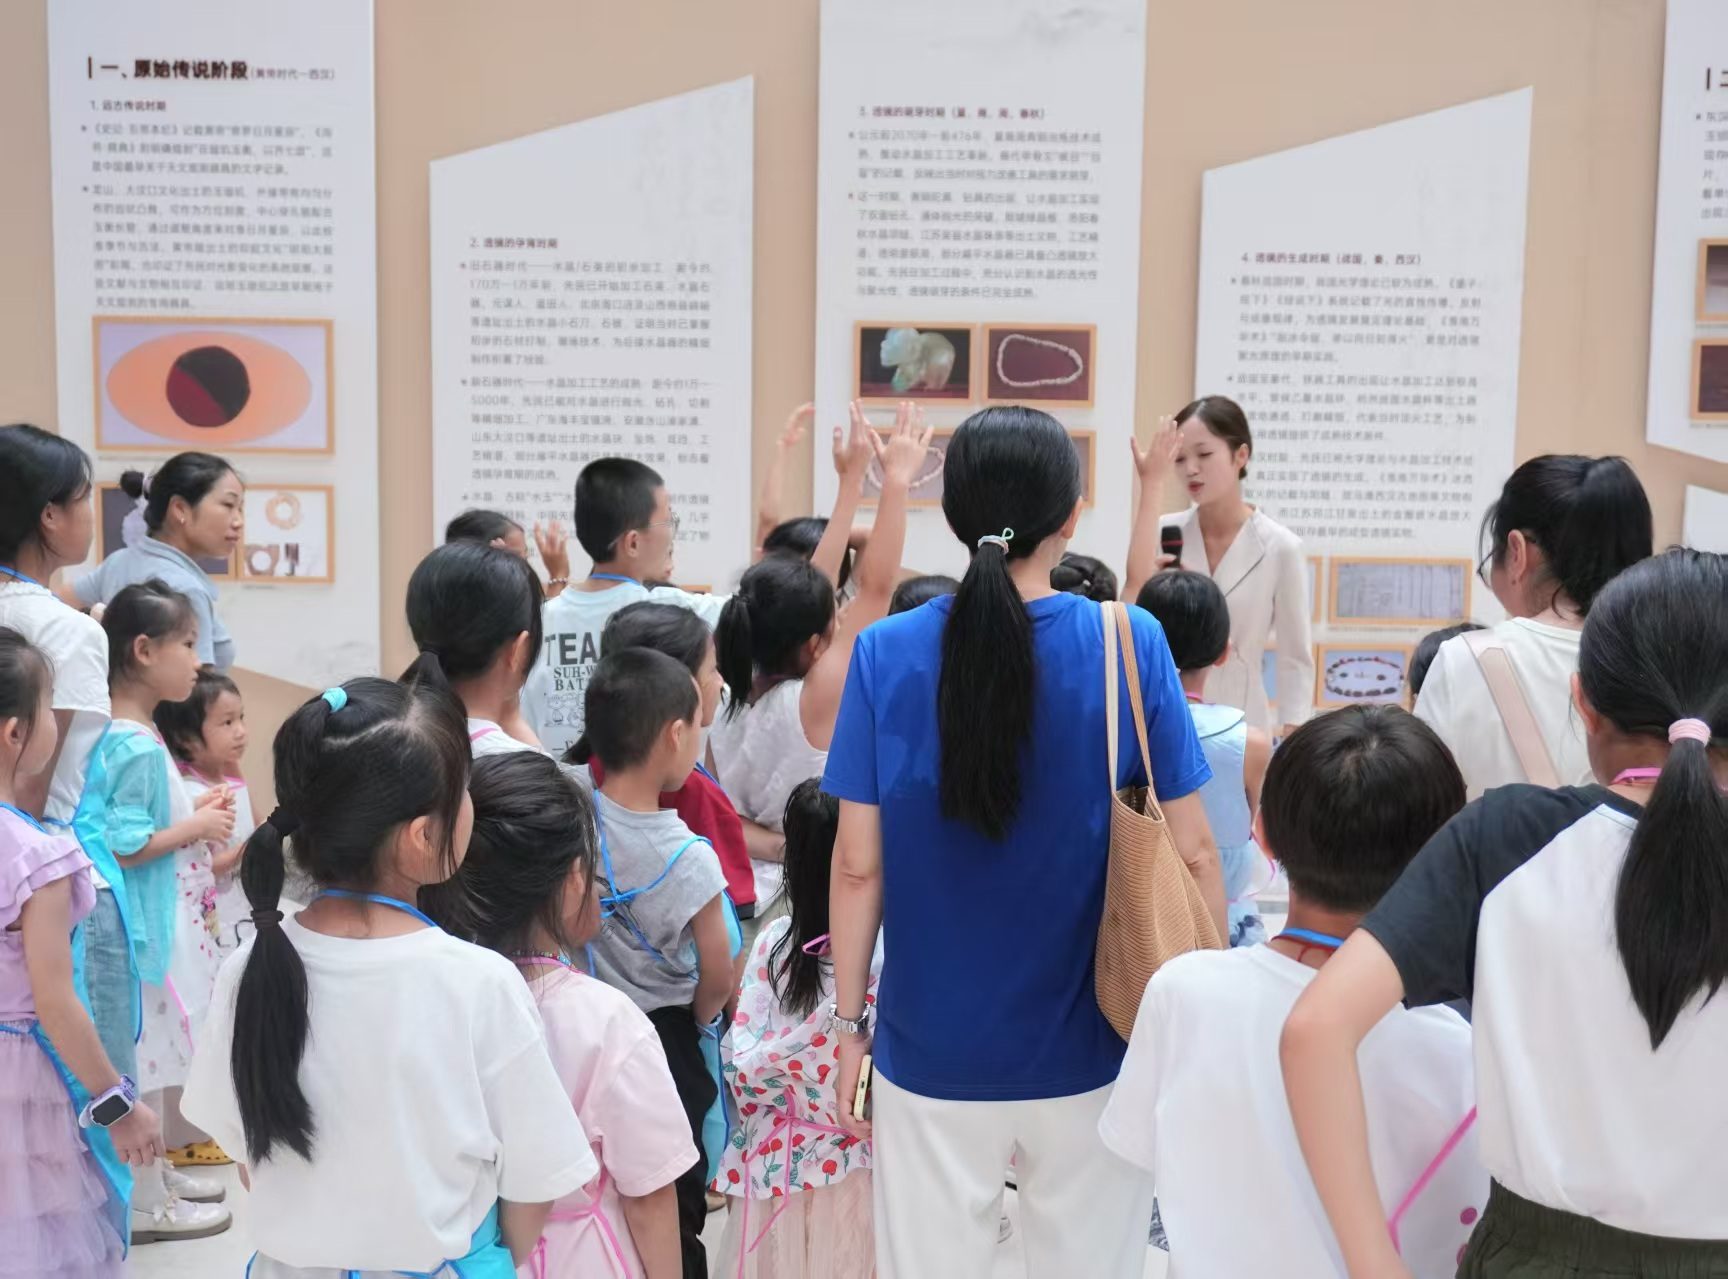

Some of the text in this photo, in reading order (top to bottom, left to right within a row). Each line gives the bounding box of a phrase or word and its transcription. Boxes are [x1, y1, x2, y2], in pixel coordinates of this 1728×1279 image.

[101, 60, 248, 80] 一、原始传说阶段
[545, 632, 605, 666] TEA
[554, 666, 597, 679] SUH-W
[555, 680, 586, 691] BAT
